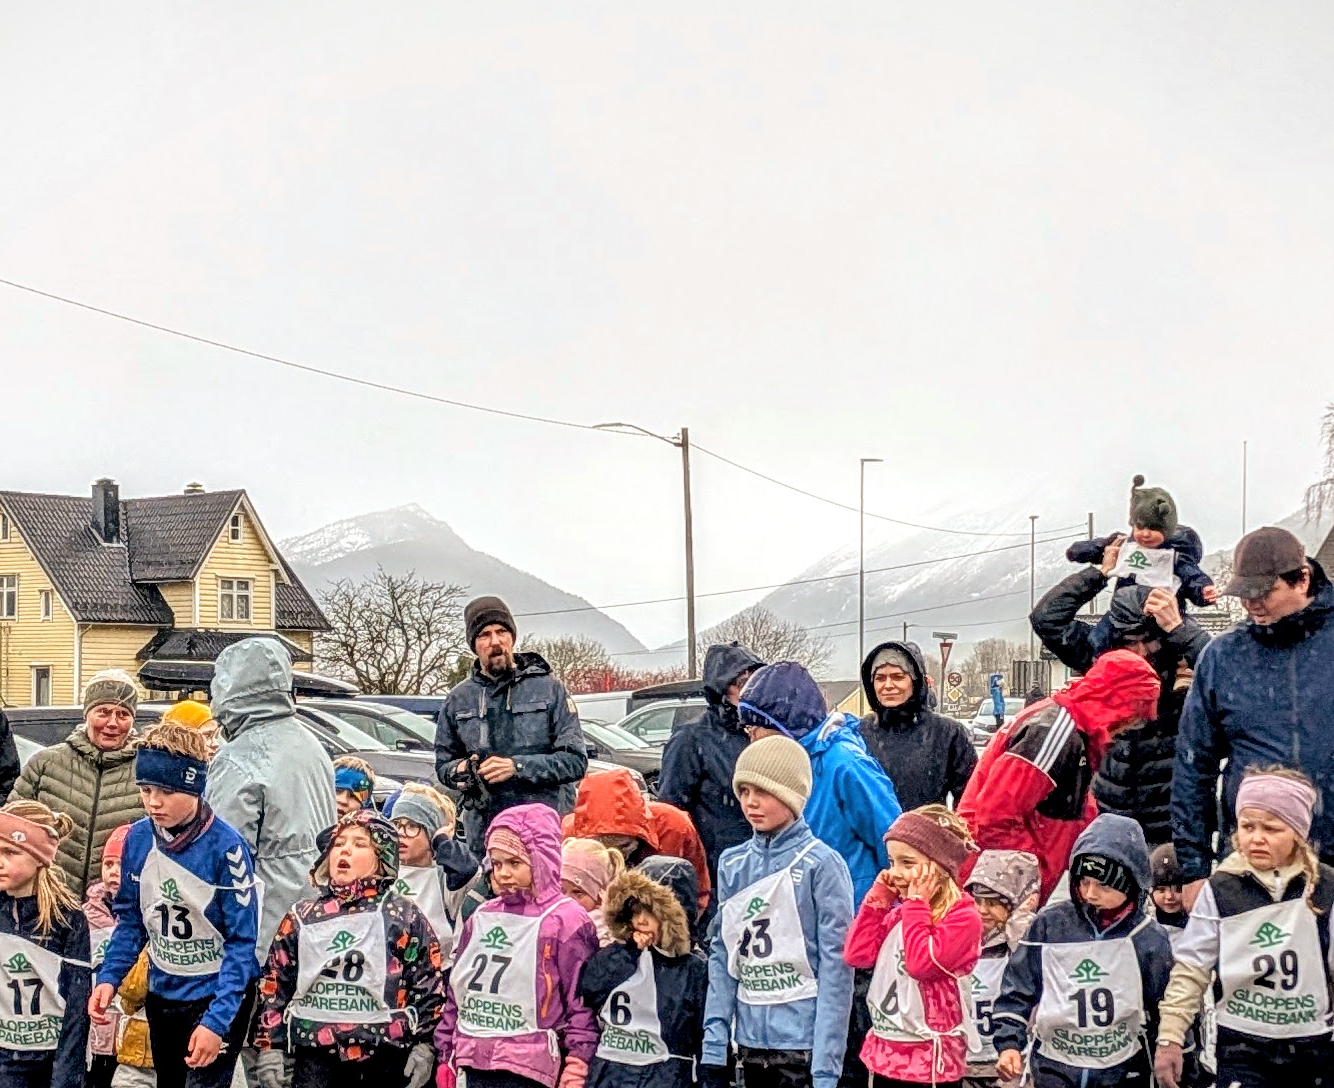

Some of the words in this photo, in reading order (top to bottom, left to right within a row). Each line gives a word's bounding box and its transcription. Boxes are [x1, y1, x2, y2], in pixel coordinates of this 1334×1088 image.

[154, 903, 193, 940] 13
[152, 932, 214, 953] OPPENS
[154, 944, 223, 966] AREBANK
[467, 953, 513, 995] 27
[1252, 949, 1298, 991] 29
[6, 978, 45, 1016] 17
[299, 995, 380, 1012] SPAREBANK
[610, 990, 633, 1026] 6
[1068, 988, 1115, 1028] 19
[1233, 989, 1315, 1011] GLOPPENS
[1226, 1000, 1317, 1025] SPAREBANK
[1051, 1032, 1133, 1058] SPAREBANK
[1054, 1022, 1128, 1046] GLOPPENS
